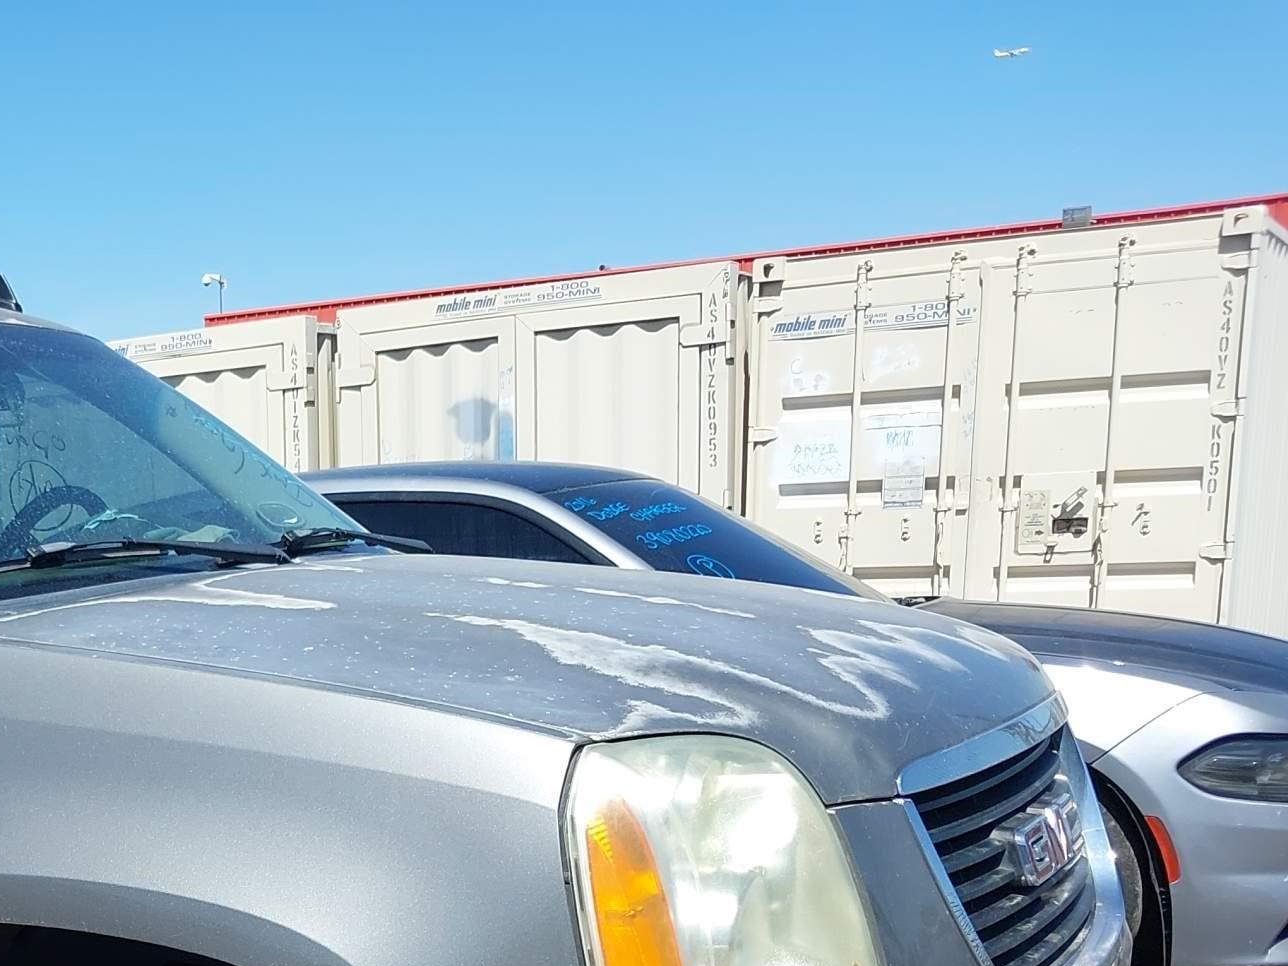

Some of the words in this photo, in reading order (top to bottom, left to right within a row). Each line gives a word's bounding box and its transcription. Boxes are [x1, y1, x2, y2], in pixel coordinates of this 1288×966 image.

[436, 297, 470, 314] mobile
[472, 294, 497, 310] mini
[911, 302, 946, 314] 1-80
[774, 315, 816, 334] mobile
[817, 314, 848, 330] mini
